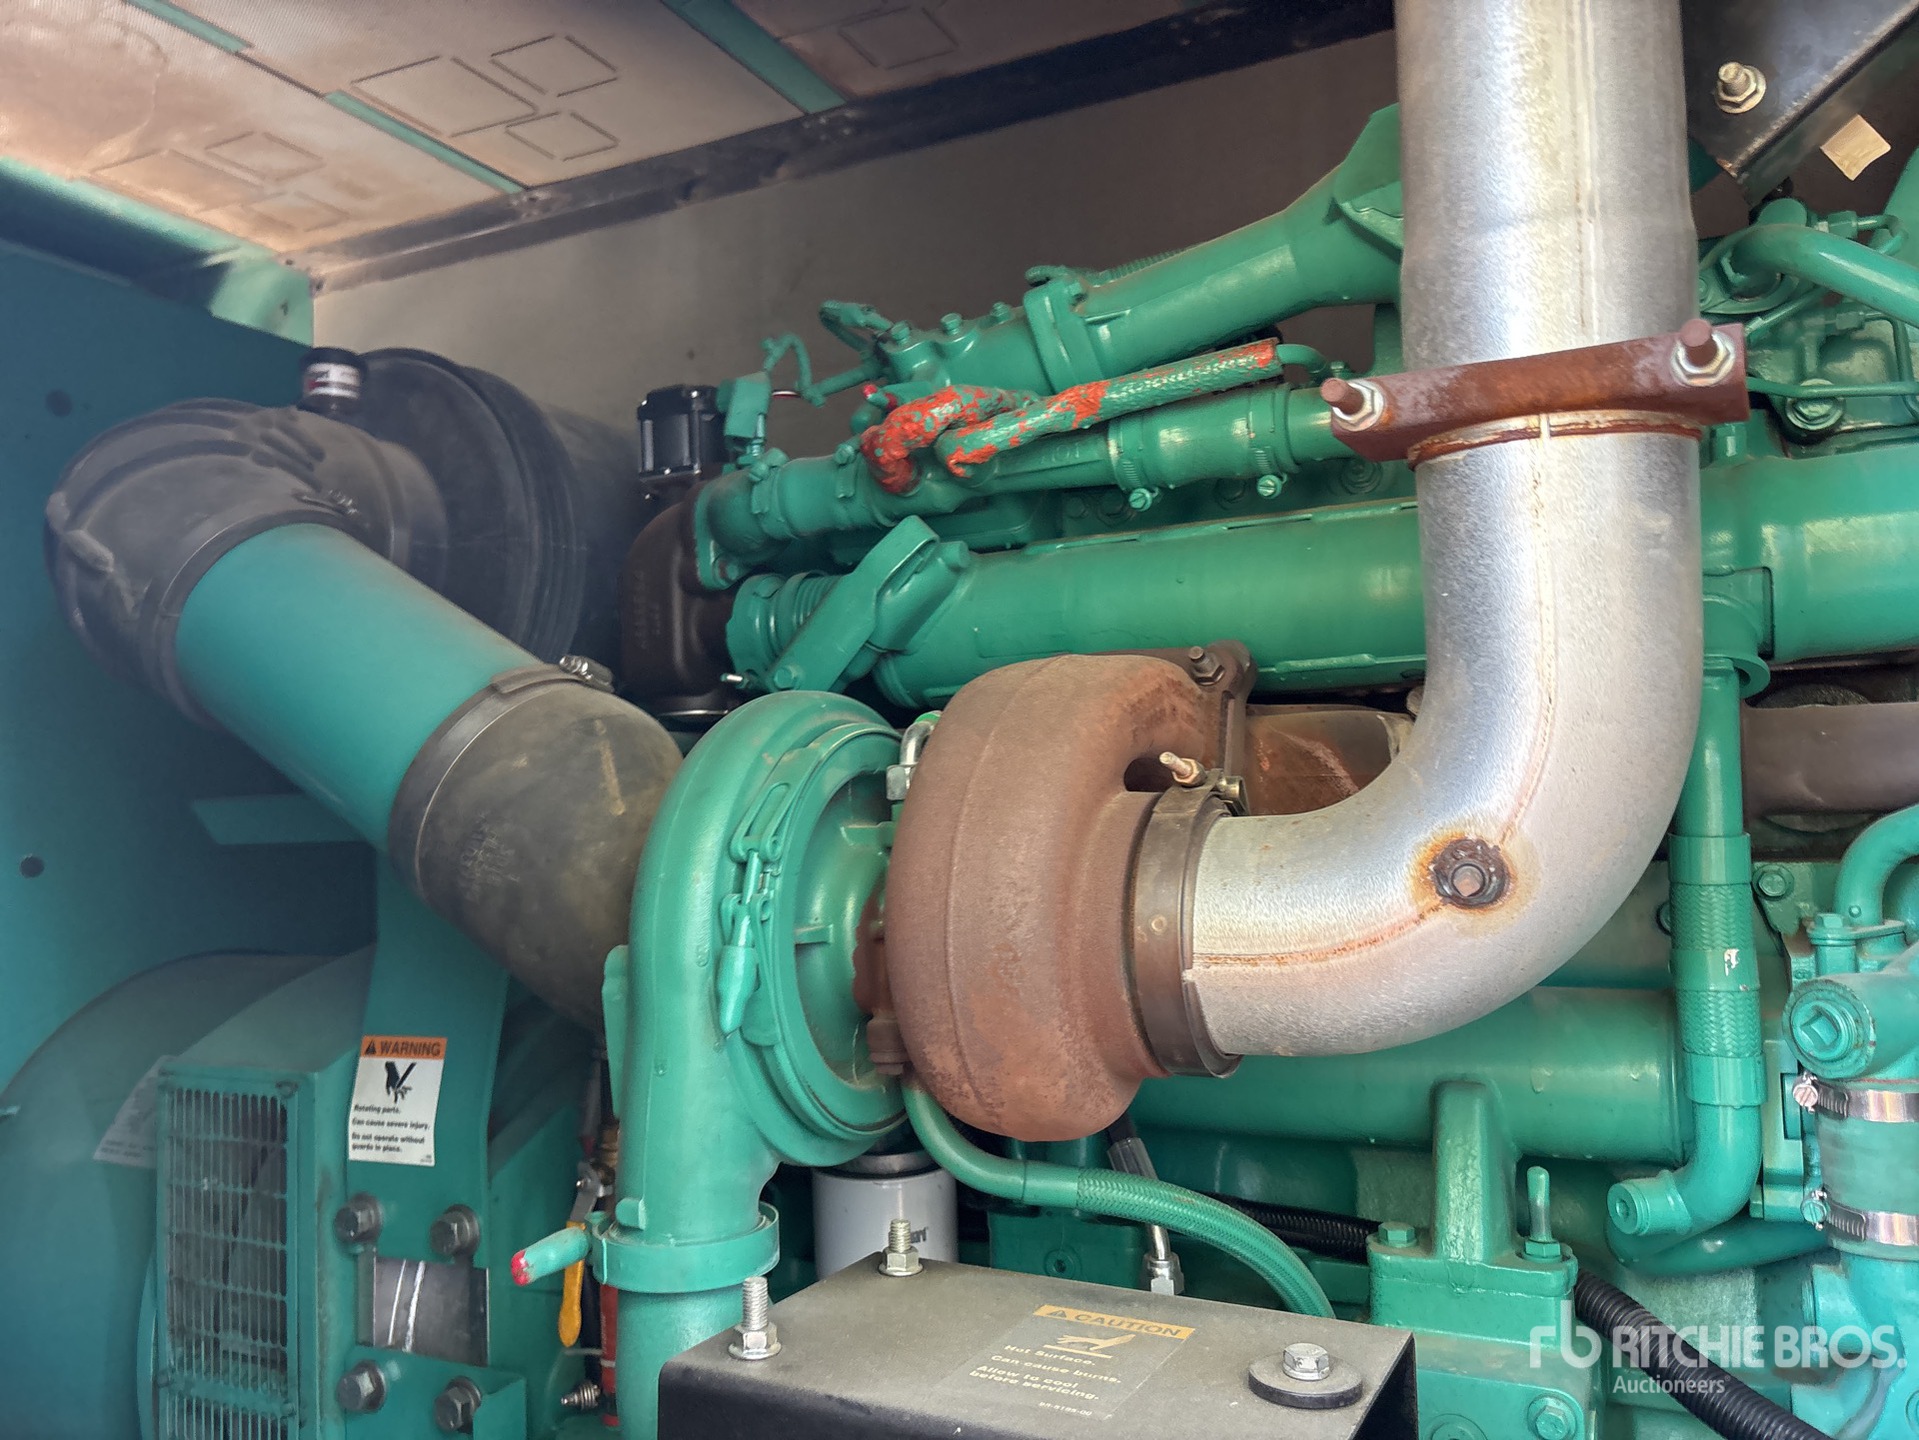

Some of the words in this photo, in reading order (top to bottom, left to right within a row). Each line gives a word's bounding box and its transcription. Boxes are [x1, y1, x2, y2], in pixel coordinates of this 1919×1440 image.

[380, 1040, 442, 1056] WARNING
[354, 1104, 381, 1114] Rotating
[352, 1117, 365, 1126] Can
[1074, 1313, 1182, 1337] CAUTION
[1004, 1345, 1031, 1353] Hot
[1035, 1350, 1096, 1366] Surface.
[976, 1365, 1020, 1377] Allow
[1023, 1373, 1040, 1381] to
[1043, 1378, 1079, 1389] cool
[991, 1355, 1020, 1365] Can
[1024, 1361, 1070, 1374] cause
[1073, 1369, 1122, 1383] burns.
[969, 1370, 1019, 1384] before
[1022, 1381, 1099, 1400] servicing.
